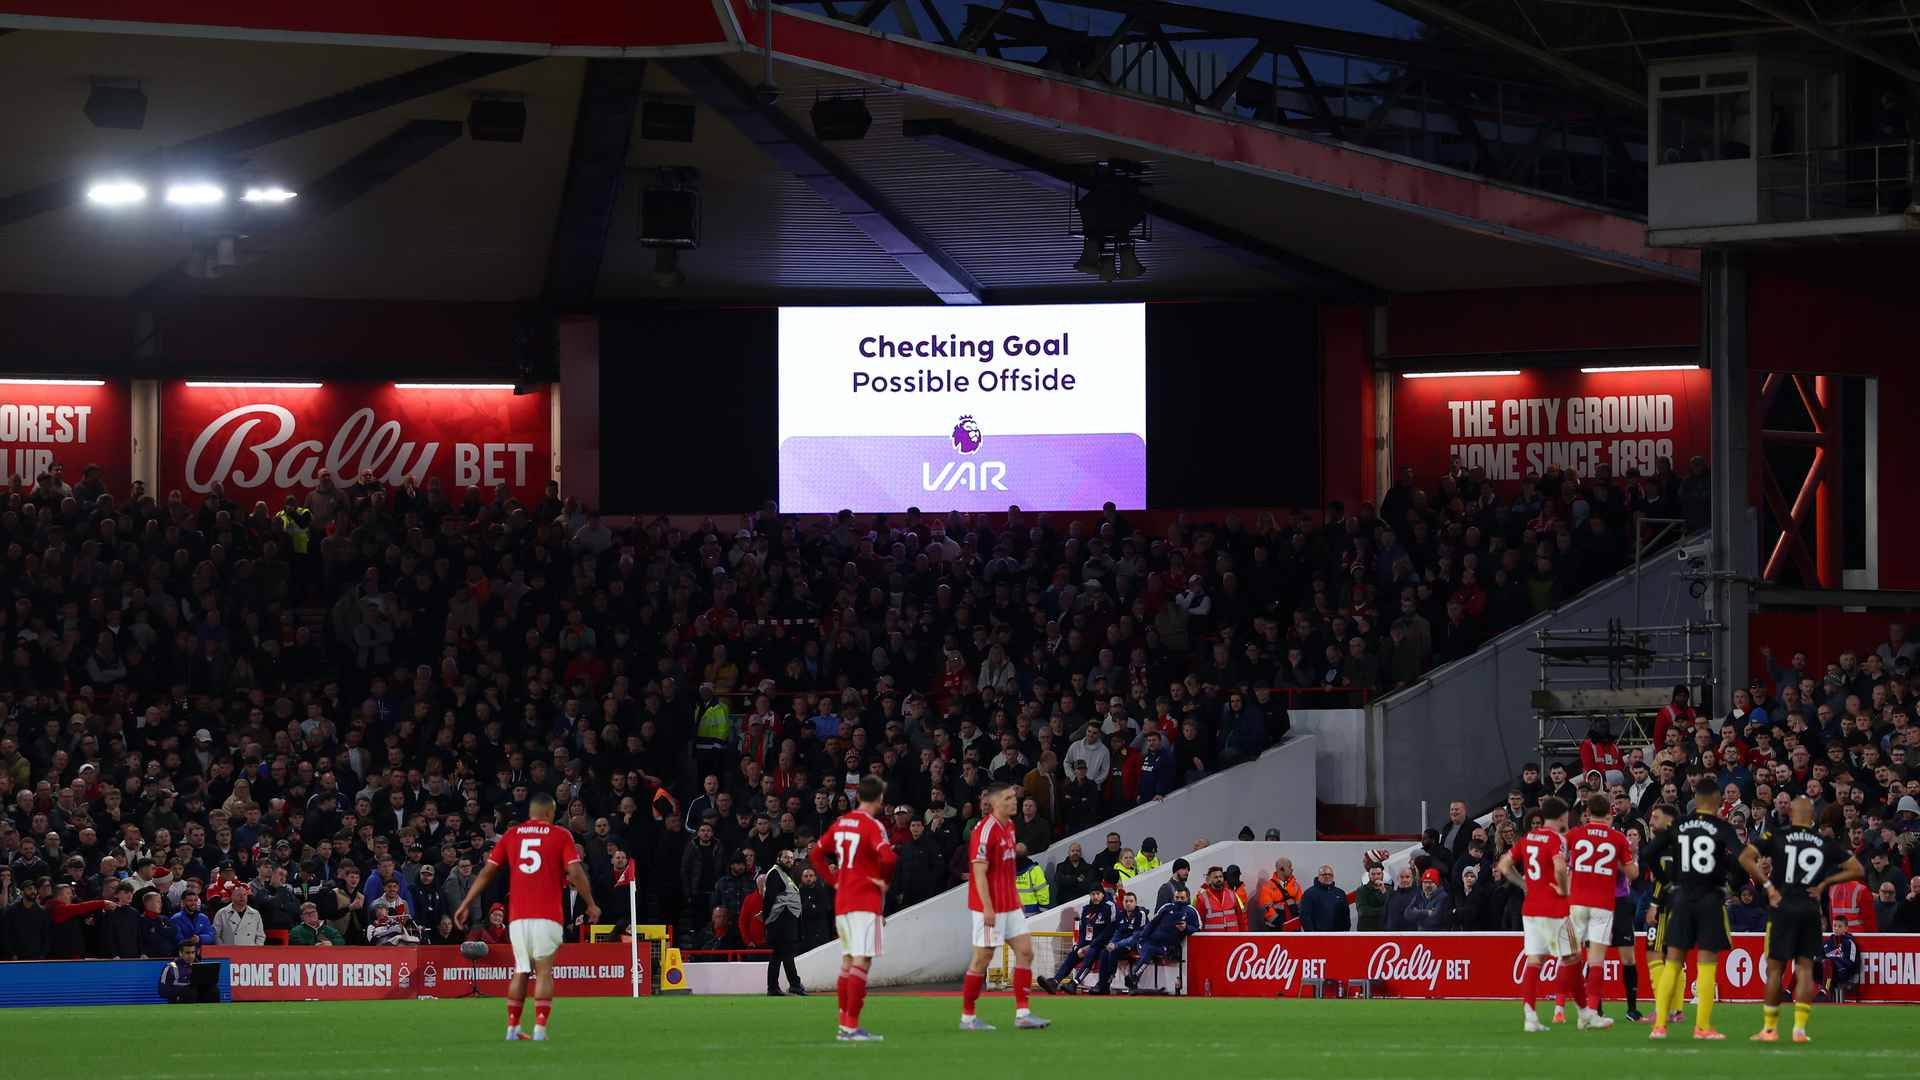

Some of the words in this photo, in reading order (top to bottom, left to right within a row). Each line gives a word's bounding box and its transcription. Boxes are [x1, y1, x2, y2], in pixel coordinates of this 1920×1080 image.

[859, 334, 994, 363] Checking
[1003, 333, 1069, 356] Goal
[853, 369, 970, 393] Possible
[978, 368, 1076, 392] Offside
[0, 404, 92, 443] OREST
[1448, 400, 1497, 438] THE
[1502, 397, 1561, 436] CITY
[1567, 395, 1674, 434] GROUND
[184, 403, 440, 493] Bally
[455, 443, 534, 487] BET
[1526, 440, 1601, 480] SINCE
[922, 461, 1009, 491] VAR
[518, 838, 542, 874] 5
[833, 831, 861, 869] 37
[1525, 845, 1541, 881] 3
[1574, 839, 1616, 876] 22
[1677, 834, 1716, 874] 18
[1784, 845, 1825, 884] 19
[1647, 926, 1657, 941] 8
[230, 963, 274, 987] COME
[277, 963, 301, 986] ON
[305, 963, 339, 986] YOU
[342, 963, 392, 987] REDS!
[443, 967, 507, 980] NOTTINGHAM
[552, 965, 597, 979] OOTBALL
[599, 965, 624, 978] CLUB
[1226, 942, 1299, 990] Bally
[1302, 959, 1327, 979] BET
[1367, 941, 1443, 991] Bally
[1446, 959, 1471, 980] BET
[1603, 959, 1620, 981] ET
[1860, 951, 1920, 985] FFICIA
